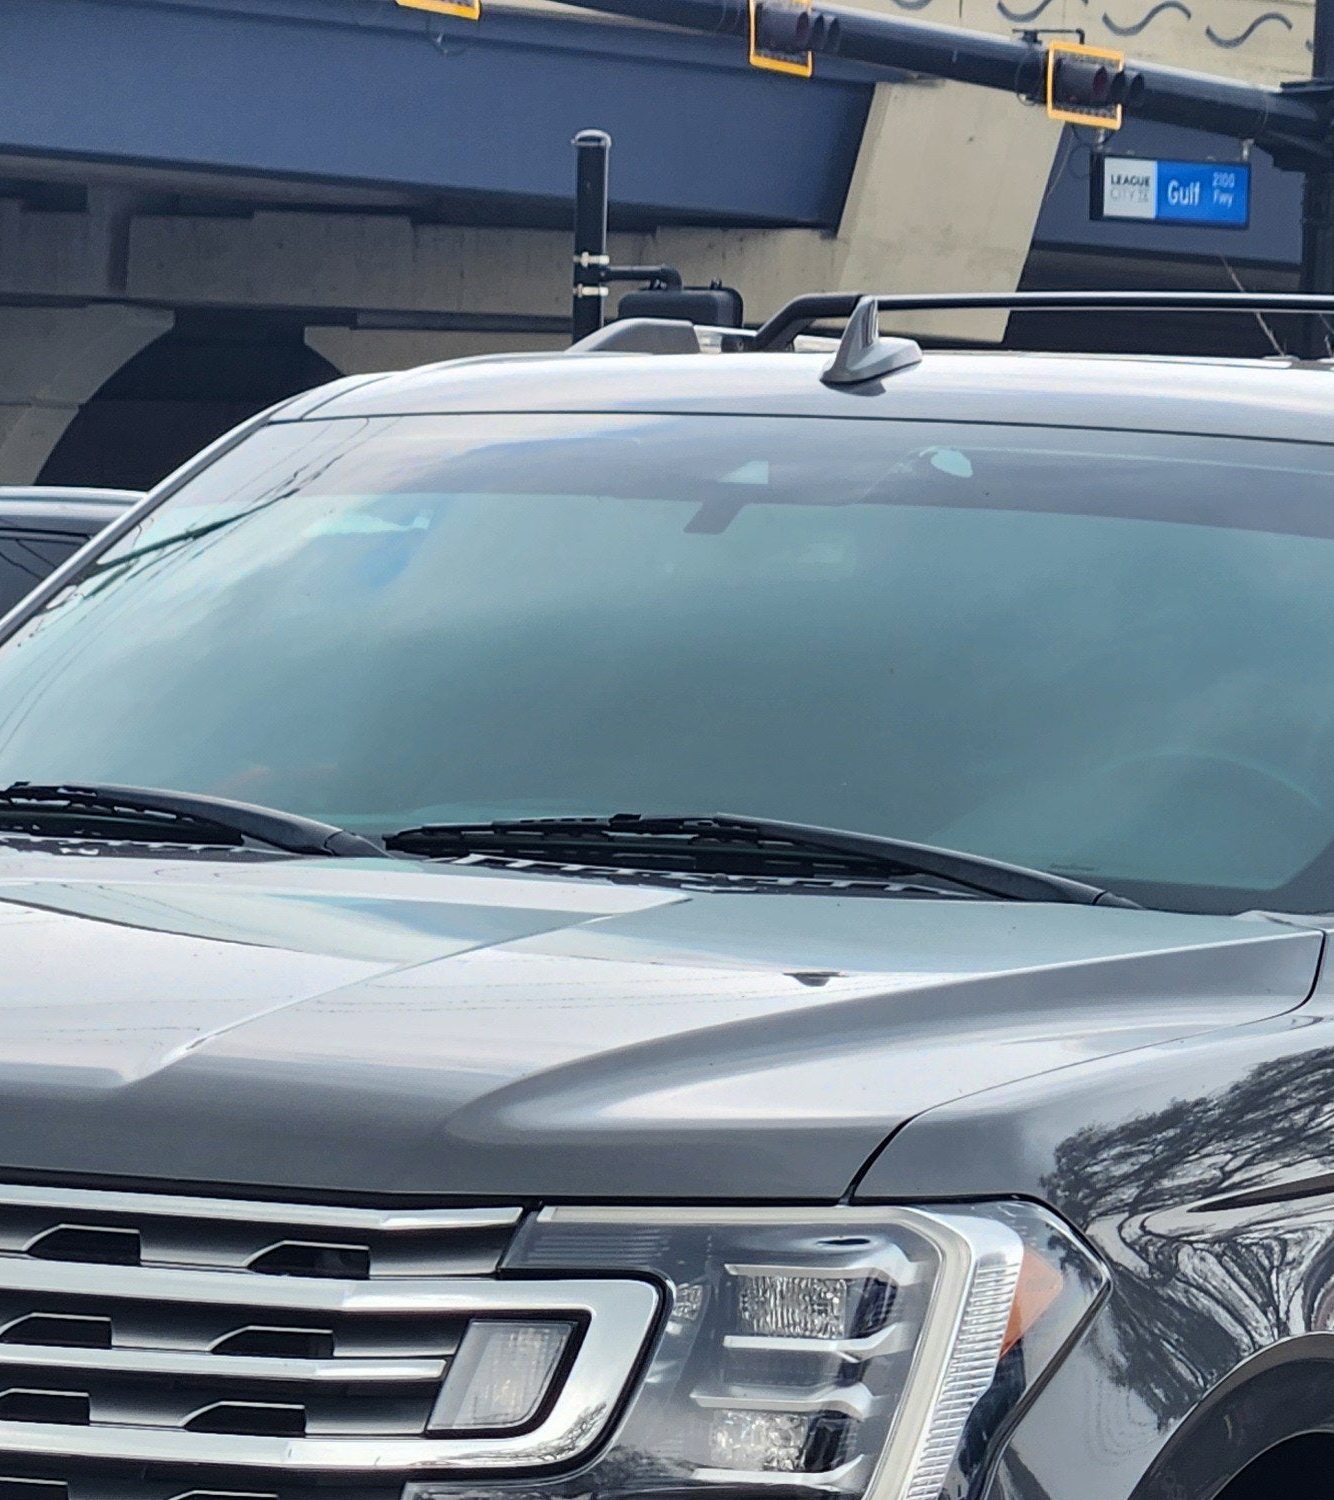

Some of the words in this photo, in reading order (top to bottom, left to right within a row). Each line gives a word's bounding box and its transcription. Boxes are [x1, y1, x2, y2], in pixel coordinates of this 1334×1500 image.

[1110, 173, 1151, 187] LEAGUE
[1167, 179, 1202, 206] Gulf
[1213, 189, 1235, 209] Fwy
